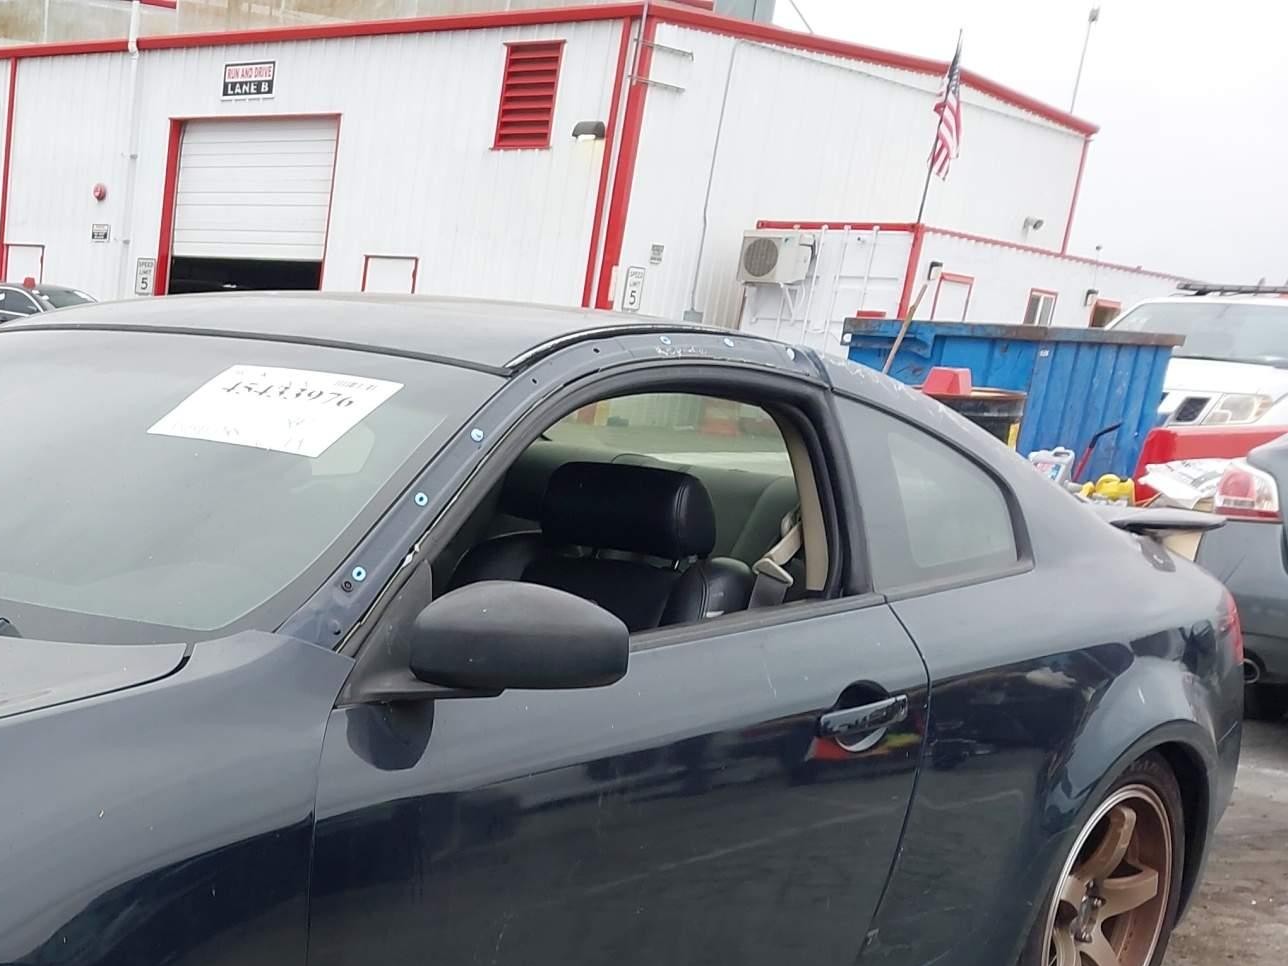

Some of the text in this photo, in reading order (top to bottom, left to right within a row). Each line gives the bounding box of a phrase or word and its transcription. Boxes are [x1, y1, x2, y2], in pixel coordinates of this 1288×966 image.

[227, 66, 272, 80] RUN AND DRIVE
[227, 81, 269, 94] LANE B
[138, 261, 154, 269] SPEED
[141, 276, 148, 290] 5
[629, 290, 636, 306] 5
[221, 380, 355, 408] 45433976
